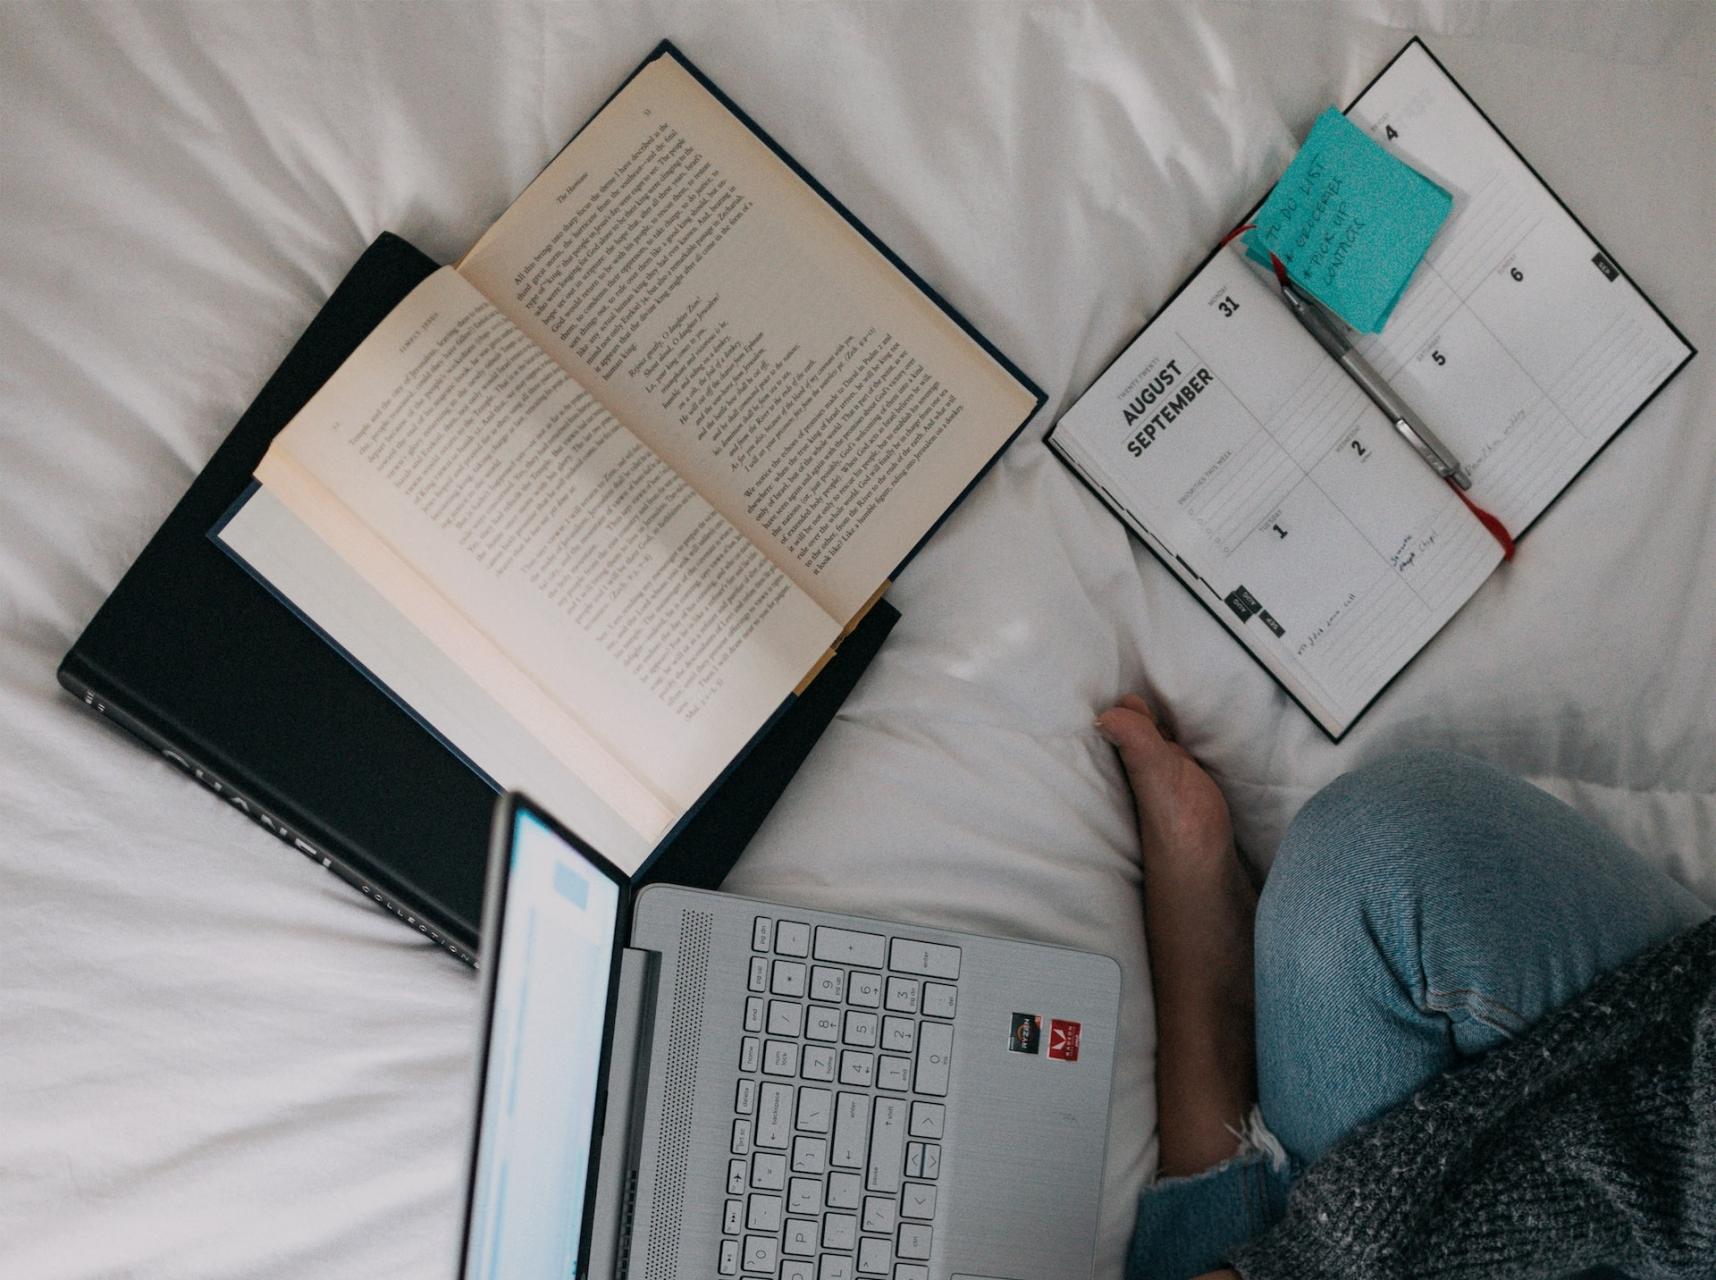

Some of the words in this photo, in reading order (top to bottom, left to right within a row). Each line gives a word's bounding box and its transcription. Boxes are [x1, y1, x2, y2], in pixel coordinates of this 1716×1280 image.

[1382, 124, 1399, 141] 4
[1279, 197, 1298, 220] DO
[1297, 152, 1327, 195] LIST
[556, 192, 567, 203] The
[1308, 231, 1335, 266] PICK
[1331, 200, 1351, 226] UP
[514, 272, 525, 285] All
[1509, 267, 1524, 282] 6
[1218, 296, 1240, 318] 31
[1431, 350, 1446, 366] 5
[1122, 359, 1182, 426] AUGUST
[1126, 368, 1214, 458] SEPTEMBER
[922, 419, 935, 431] And
[856, 442, 869, 456] God
[1351, 440, 1366, 456] 2
[858, 474, 871, 489] God
[841, 528, 855, 541] Like
[1272, 523, 1288, 539] 1
[795, 1232, 807, 1242] P
[755, 1249, 766, 1259] 0
[831, 1269, 841, 1277] L
